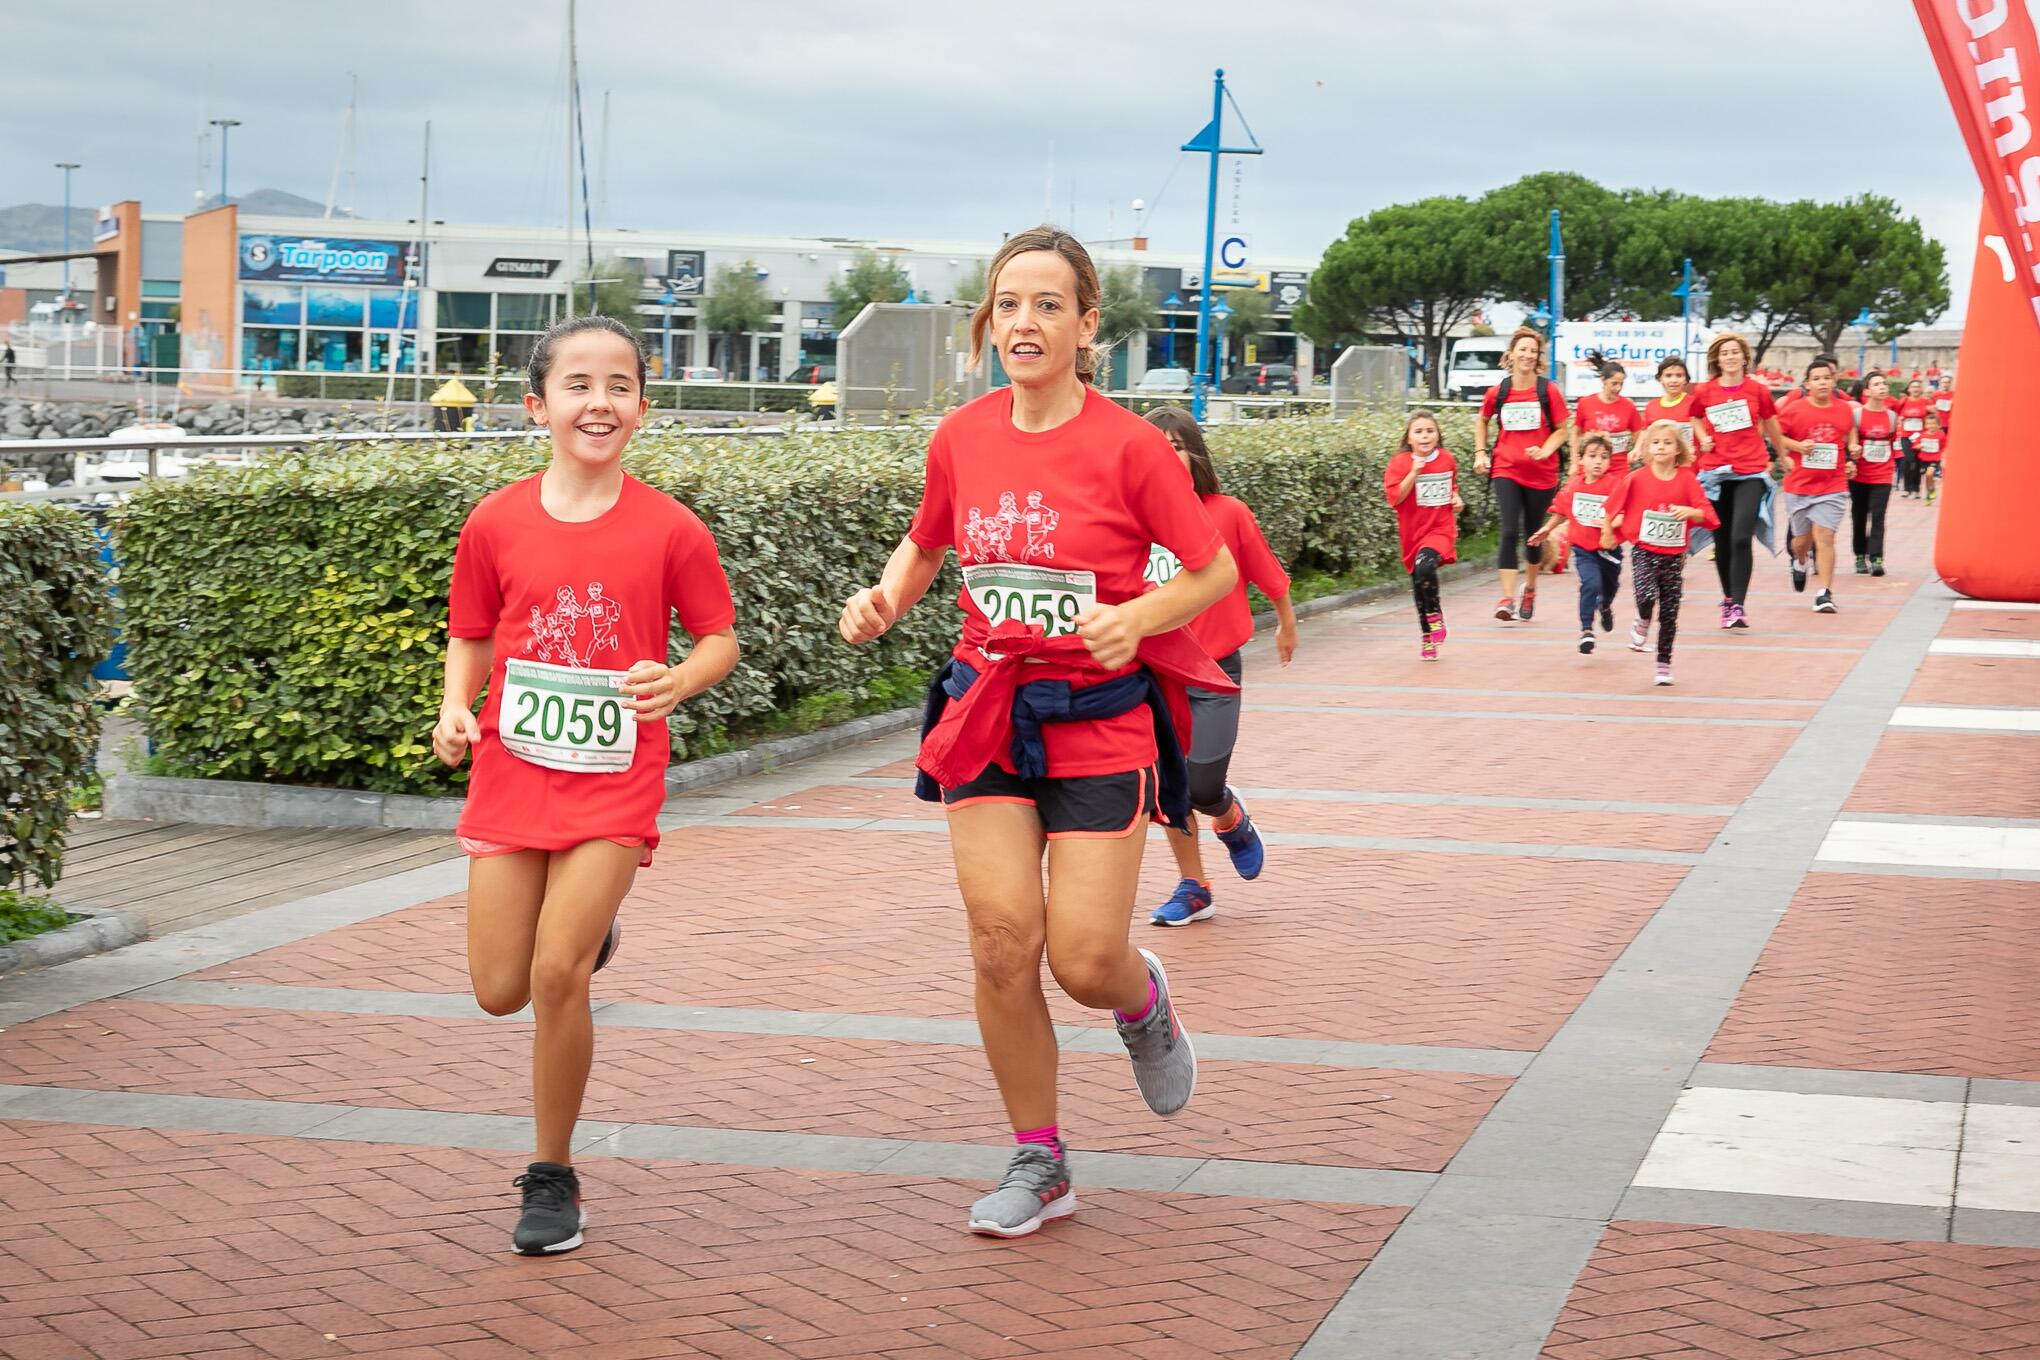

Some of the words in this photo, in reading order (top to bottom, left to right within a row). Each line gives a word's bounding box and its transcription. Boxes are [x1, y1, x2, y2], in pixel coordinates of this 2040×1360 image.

[281, 244, 386, 272] Tarpoon
[1221, 237, 1247, 269] C
[1647, 520, 1683, 539] 2050
[984, 589, 1080, 637] 2059
[513, 690, 622, 747] 2059
